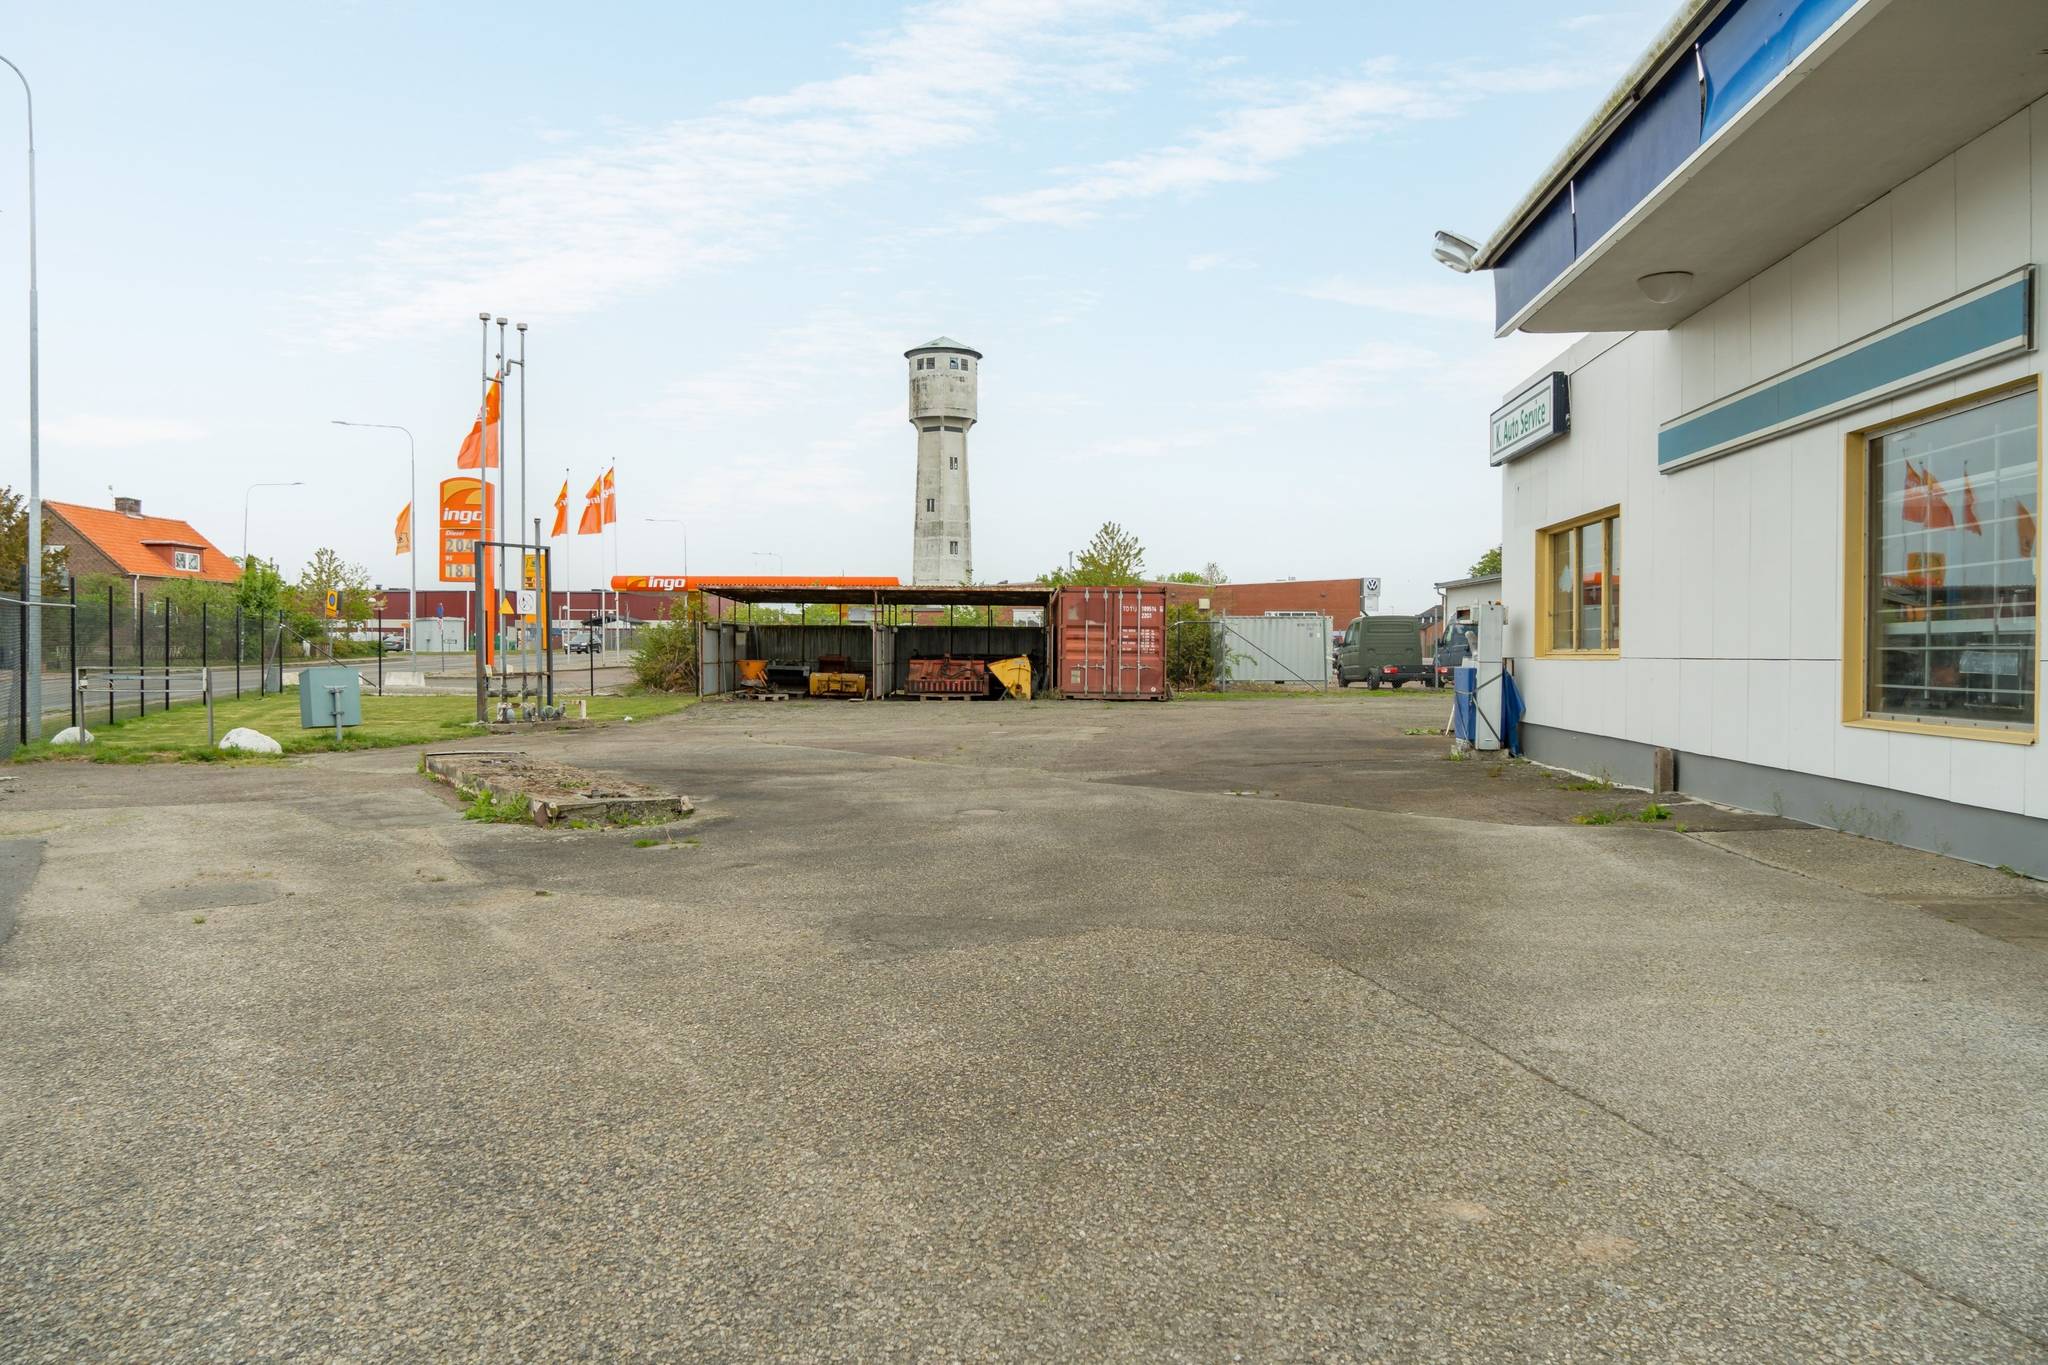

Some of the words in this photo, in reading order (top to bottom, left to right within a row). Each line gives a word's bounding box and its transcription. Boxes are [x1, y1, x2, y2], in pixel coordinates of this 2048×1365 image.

[1503, 417, 1519, 445] Auto
[1520, 402, 1546, 435] Service
[443, 507, 483, 525] ingo
[648, 576, 686, 591] ingo
